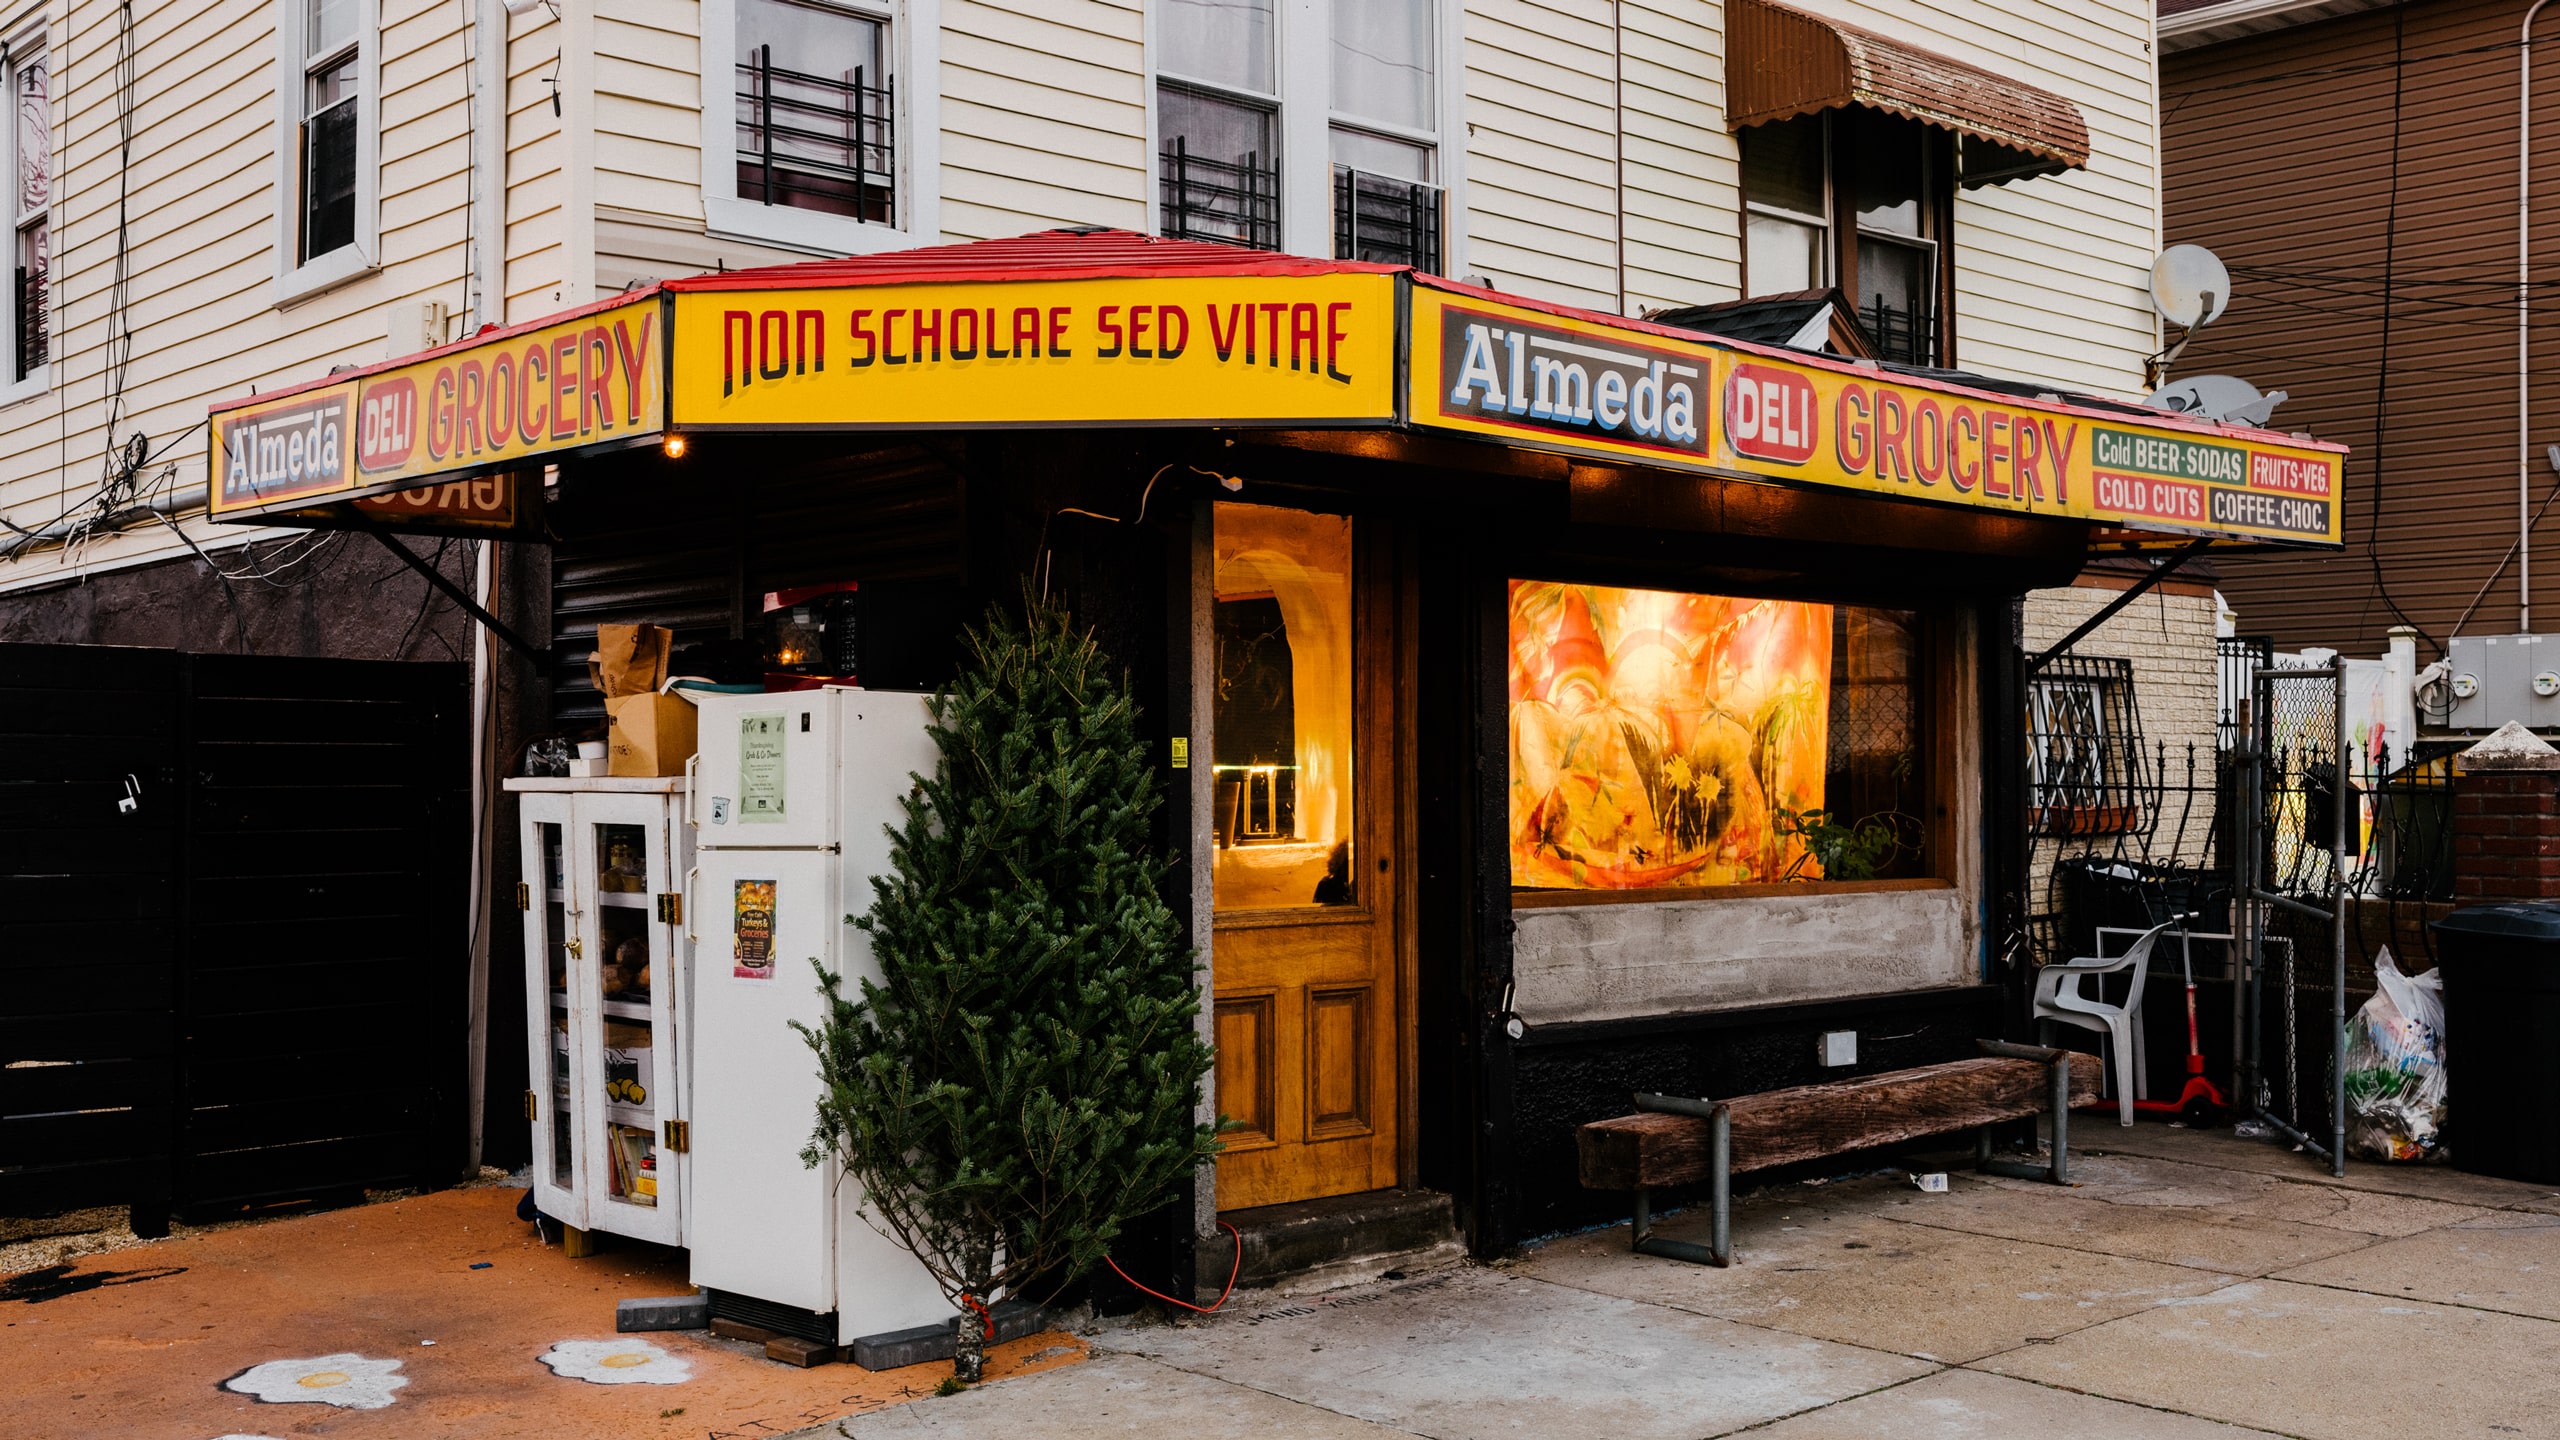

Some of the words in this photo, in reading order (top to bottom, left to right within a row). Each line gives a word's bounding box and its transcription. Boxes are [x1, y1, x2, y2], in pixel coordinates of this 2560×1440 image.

[428, 311, 654, 462] GROCERY
[723, 309, 825, 400] NON
[850, 305, 1072, 368] SCHOLAE
[1097, 304, 1190, 360] SED
[1206, 301, 1354, 385] VITAE
[1451, 322, 1698, 444] Almeda
[225, 404, 340, 495] Almeda
[364, 389, 413, 457] DELI
[1736, 375, 1810, 449] DELI
[1835, 380, 2078, 505] GROCERY
[2097, 433, 2131, 466] Cold
[2099, 476, 2147, 511] COLD
[2153, 483, 2200, 517] CUTS
